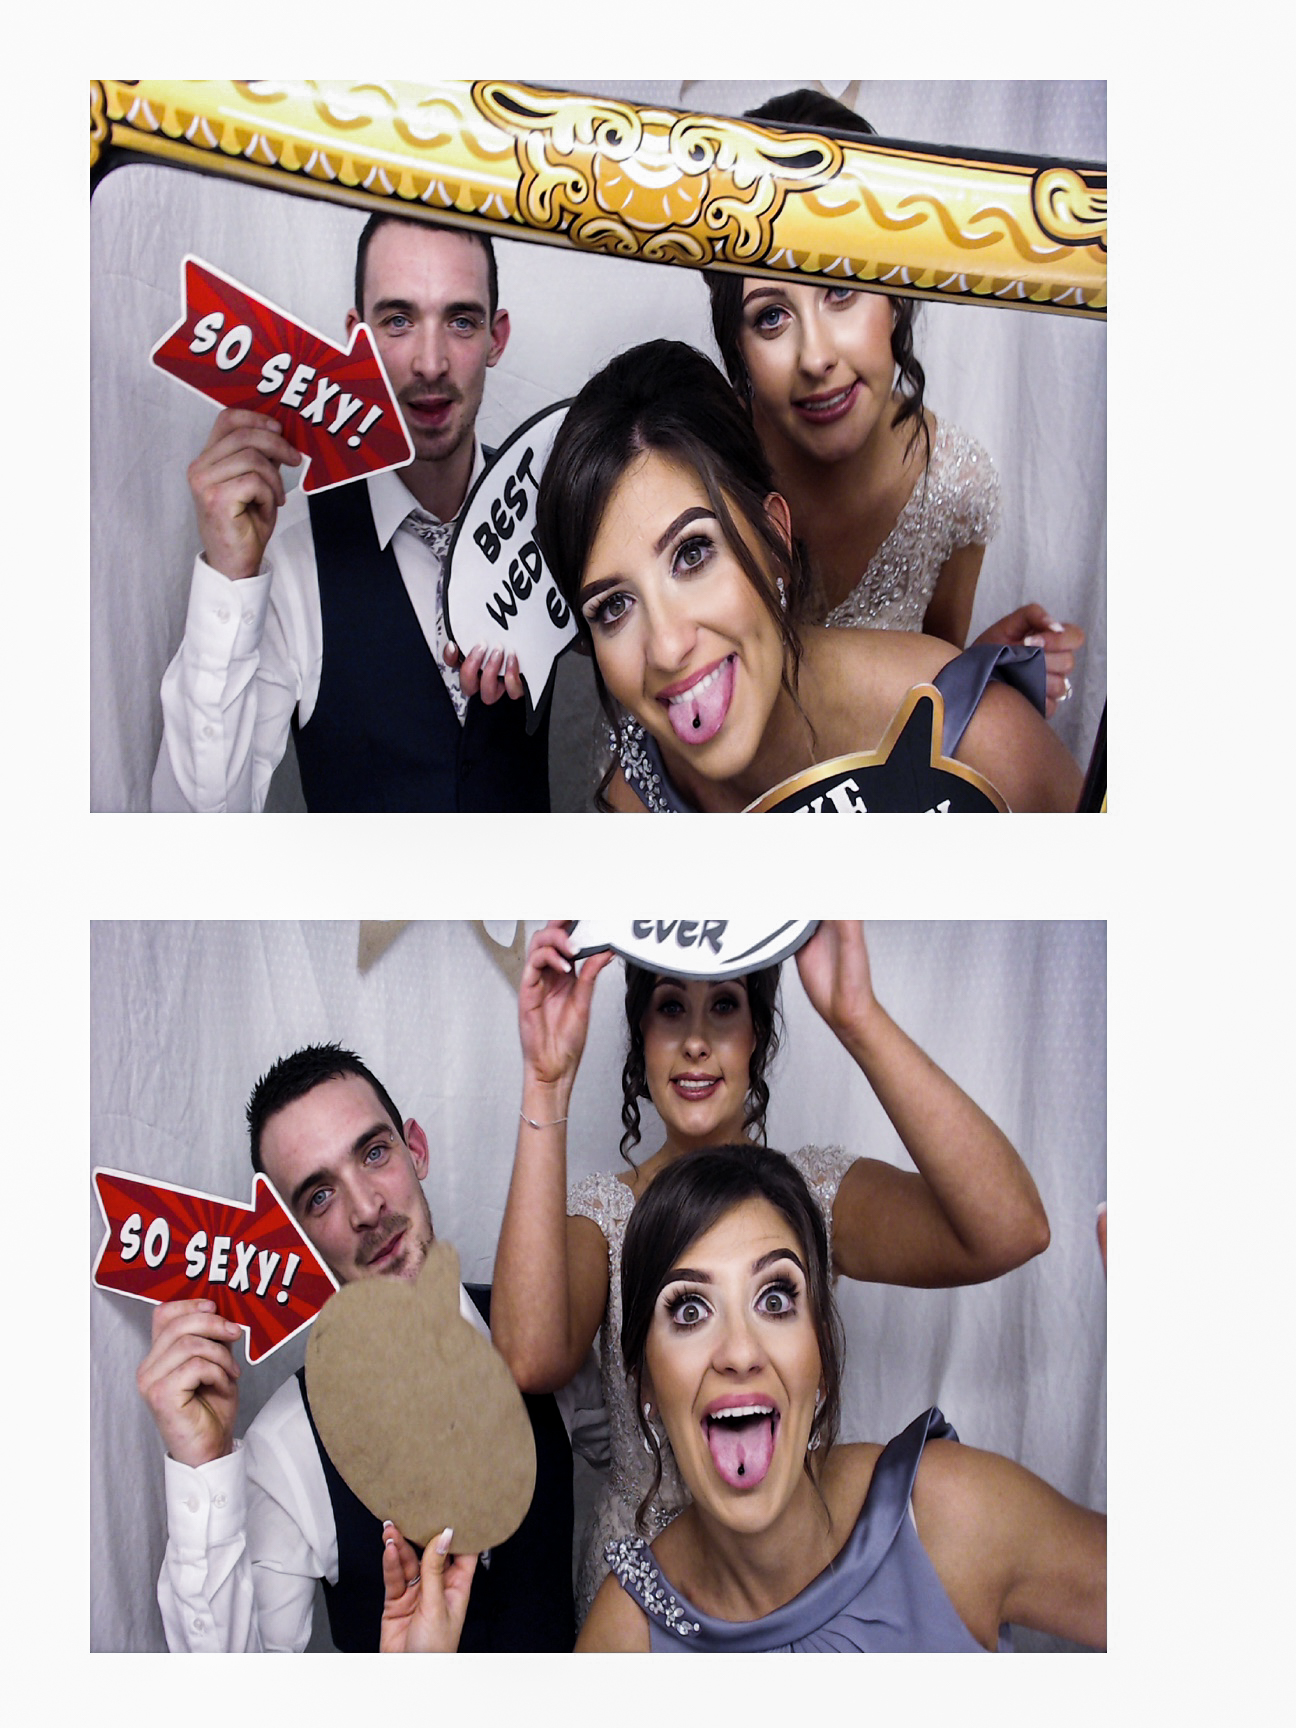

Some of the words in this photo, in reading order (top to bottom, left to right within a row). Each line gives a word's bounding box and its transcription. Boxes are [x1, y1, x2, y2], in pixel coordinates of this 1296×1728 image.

[188, 311, 253, 371] SO
[256, 352, 384, 450] SEXY!
[473, 446, 540, 565] BEST
[486, 534, 543, 631] WED
[632, 919, 730, 956] EVER
[119, 1213, 171, 1268] SO
[185, 1230, 302, 1306] SEXY!
